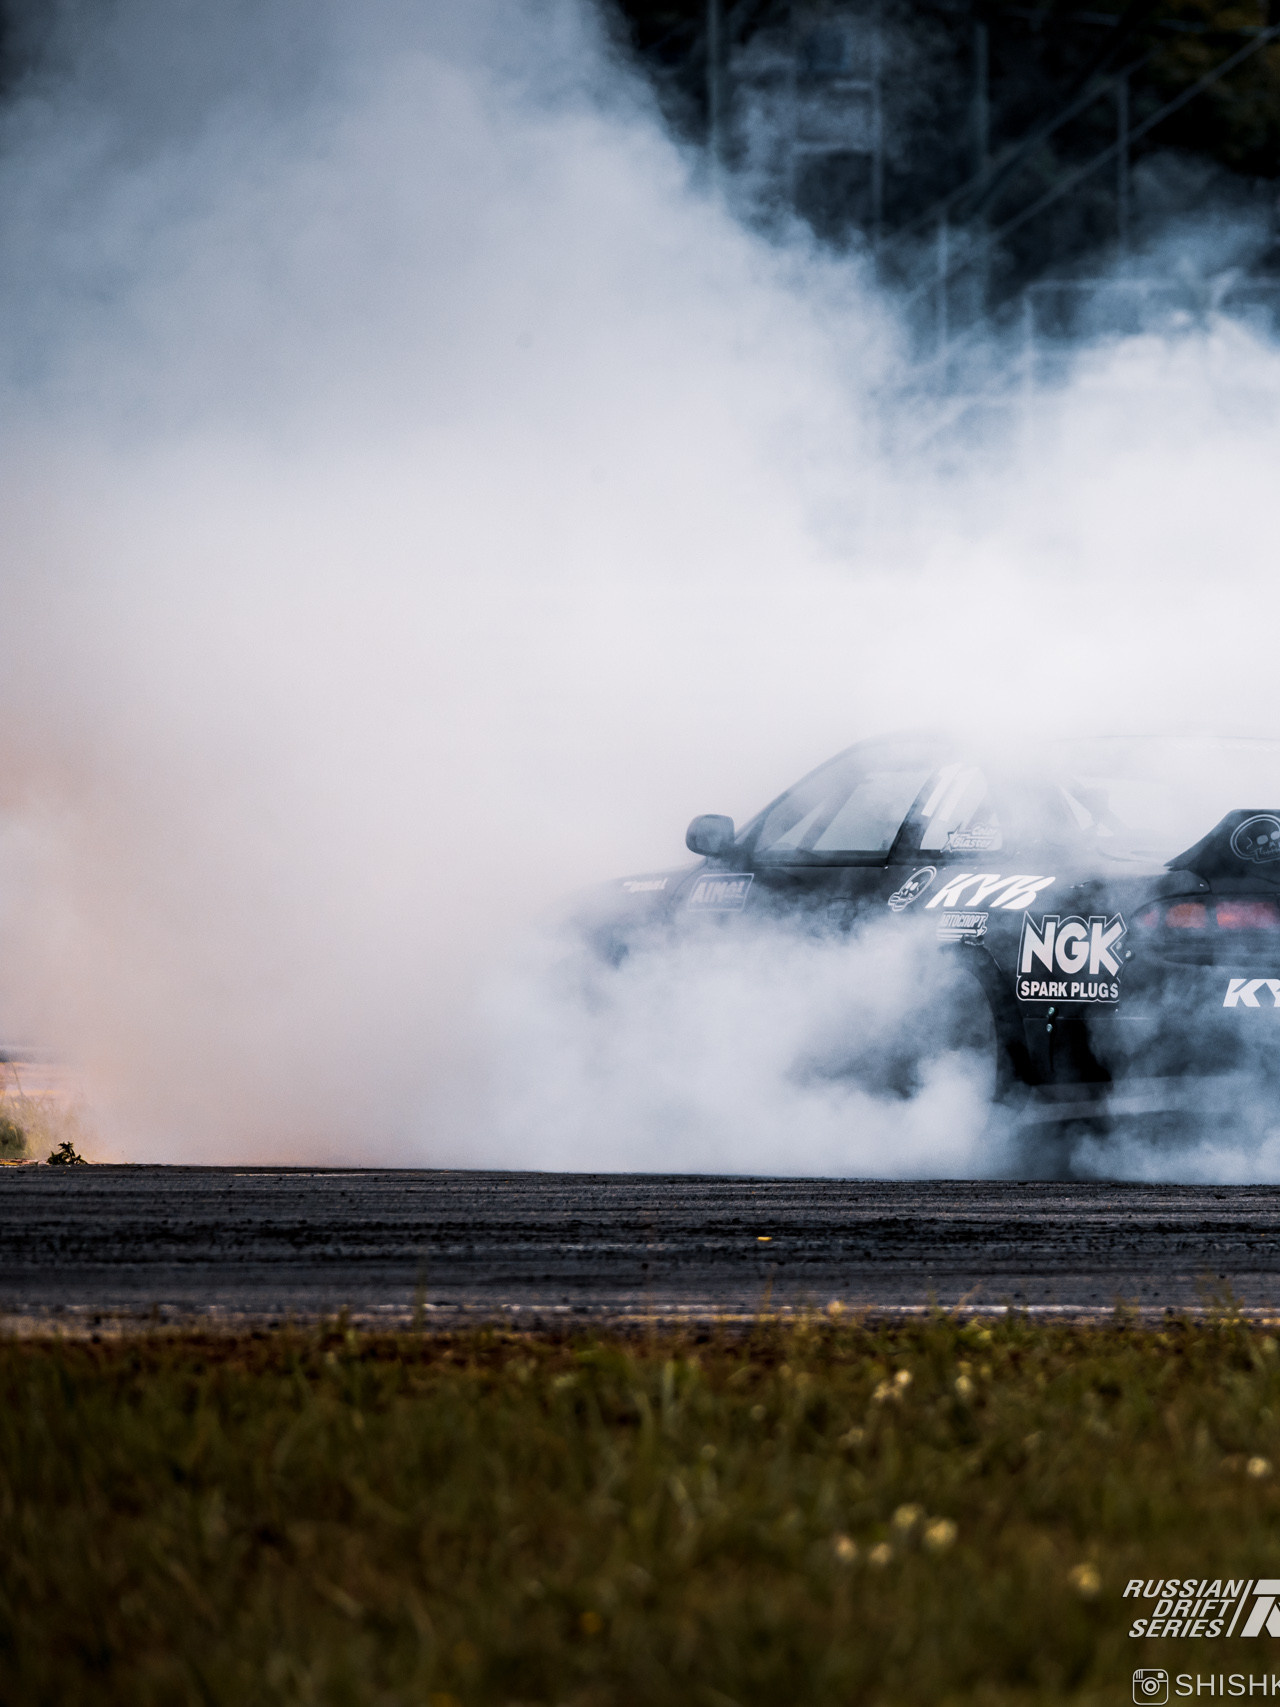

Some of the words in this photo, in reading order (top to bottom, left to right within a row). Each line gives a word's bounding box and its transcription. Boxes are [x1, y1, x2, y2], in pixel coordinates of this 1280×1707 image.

[925, 873, 1057, 910] KYB
[1021, 921, 1123, 977] NGK
[1020, 980, 1068, 997] SPARK
[1070, 982, 1119, 998] PLUGS
